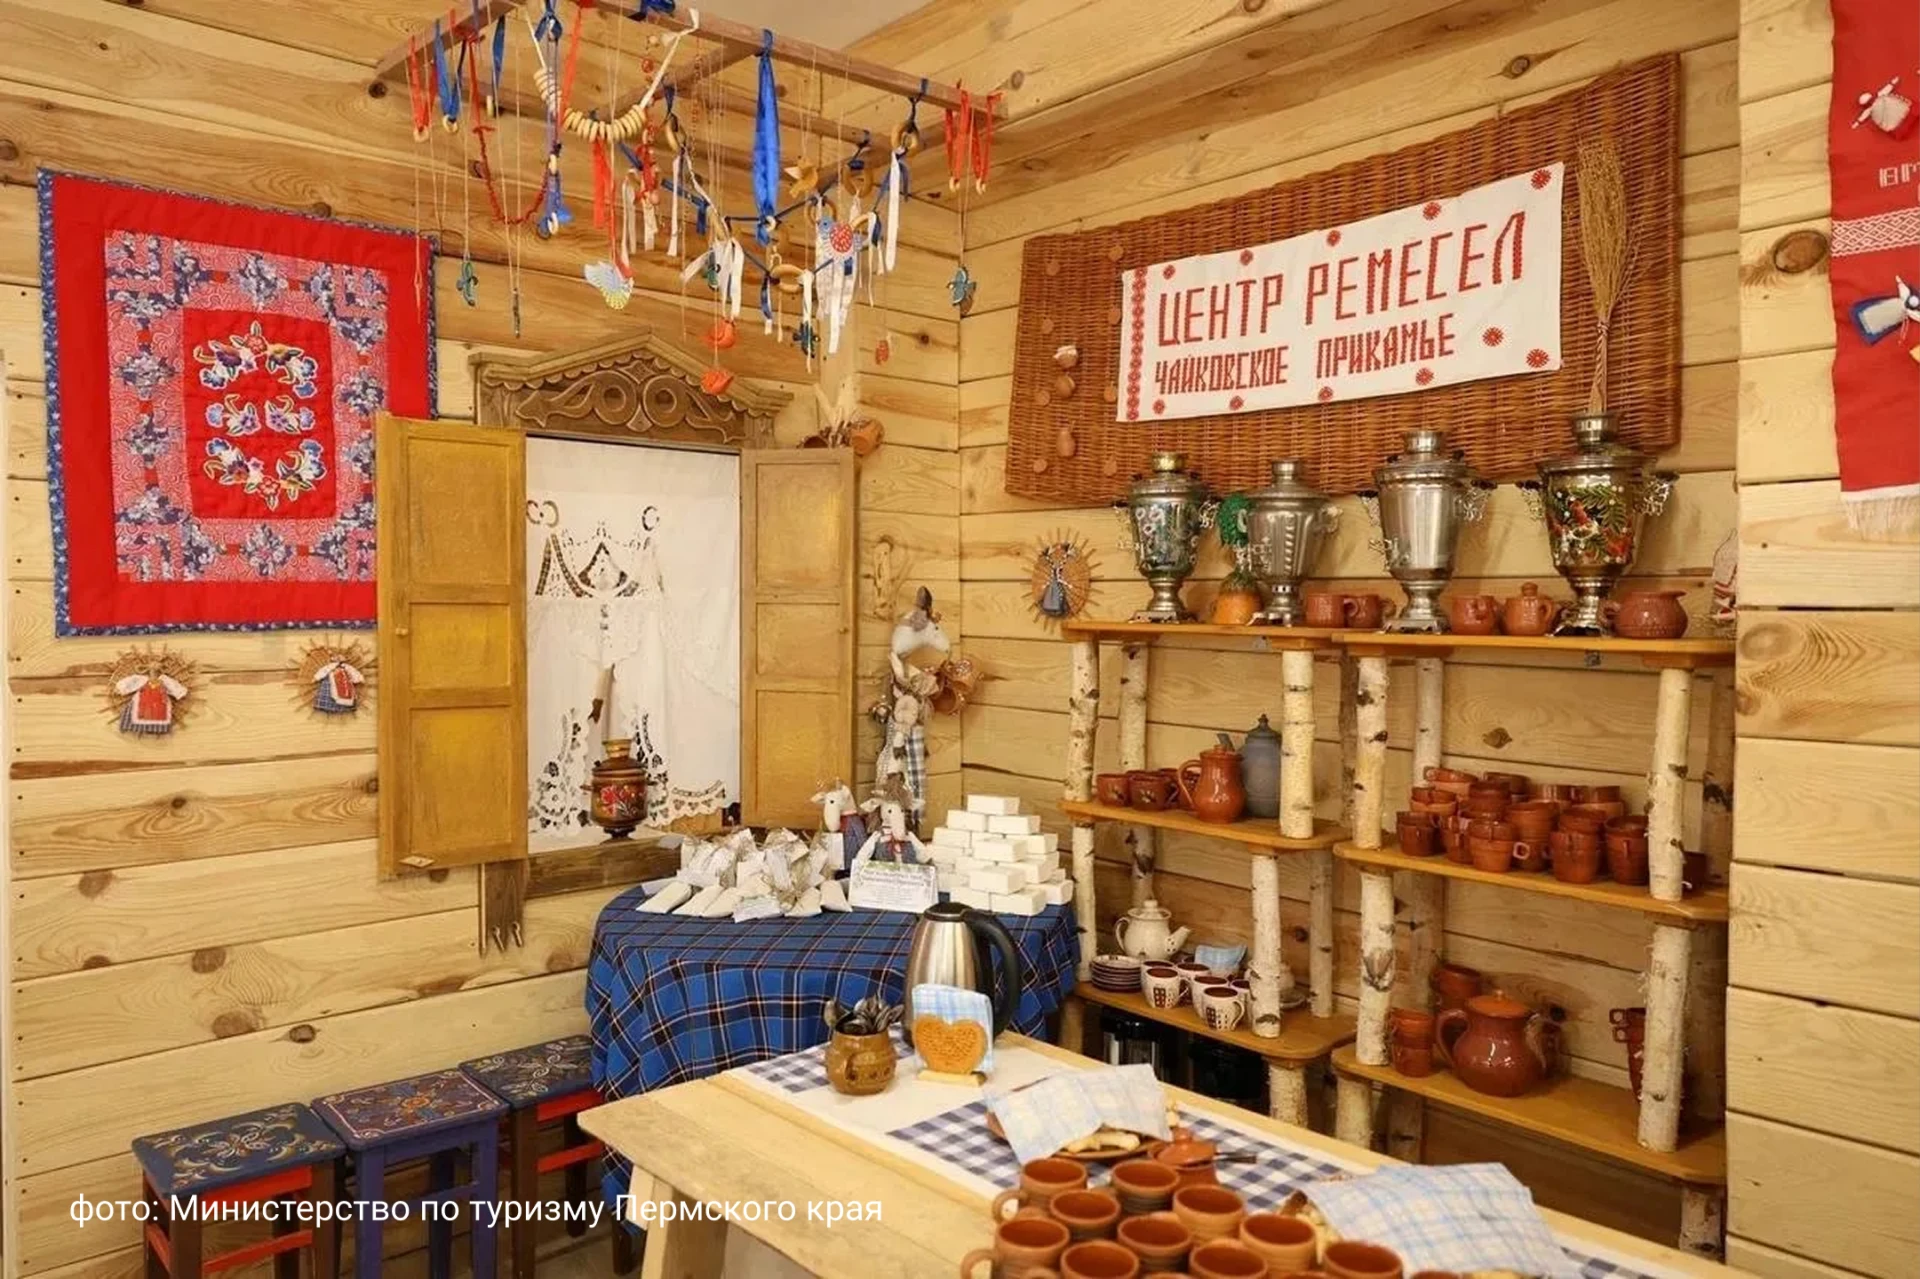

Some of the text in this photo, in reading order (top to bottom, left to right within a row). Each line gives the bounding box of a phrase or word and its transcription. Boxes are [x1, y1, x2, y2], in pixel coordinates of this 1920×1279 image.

[1158, 211, 1528, 348] ЦЕНТР РЕМЕСЕЛ
[1154, 312, 1456, 395] ЧАЙКОВСКОЕ ПРИКАМЬЕ
